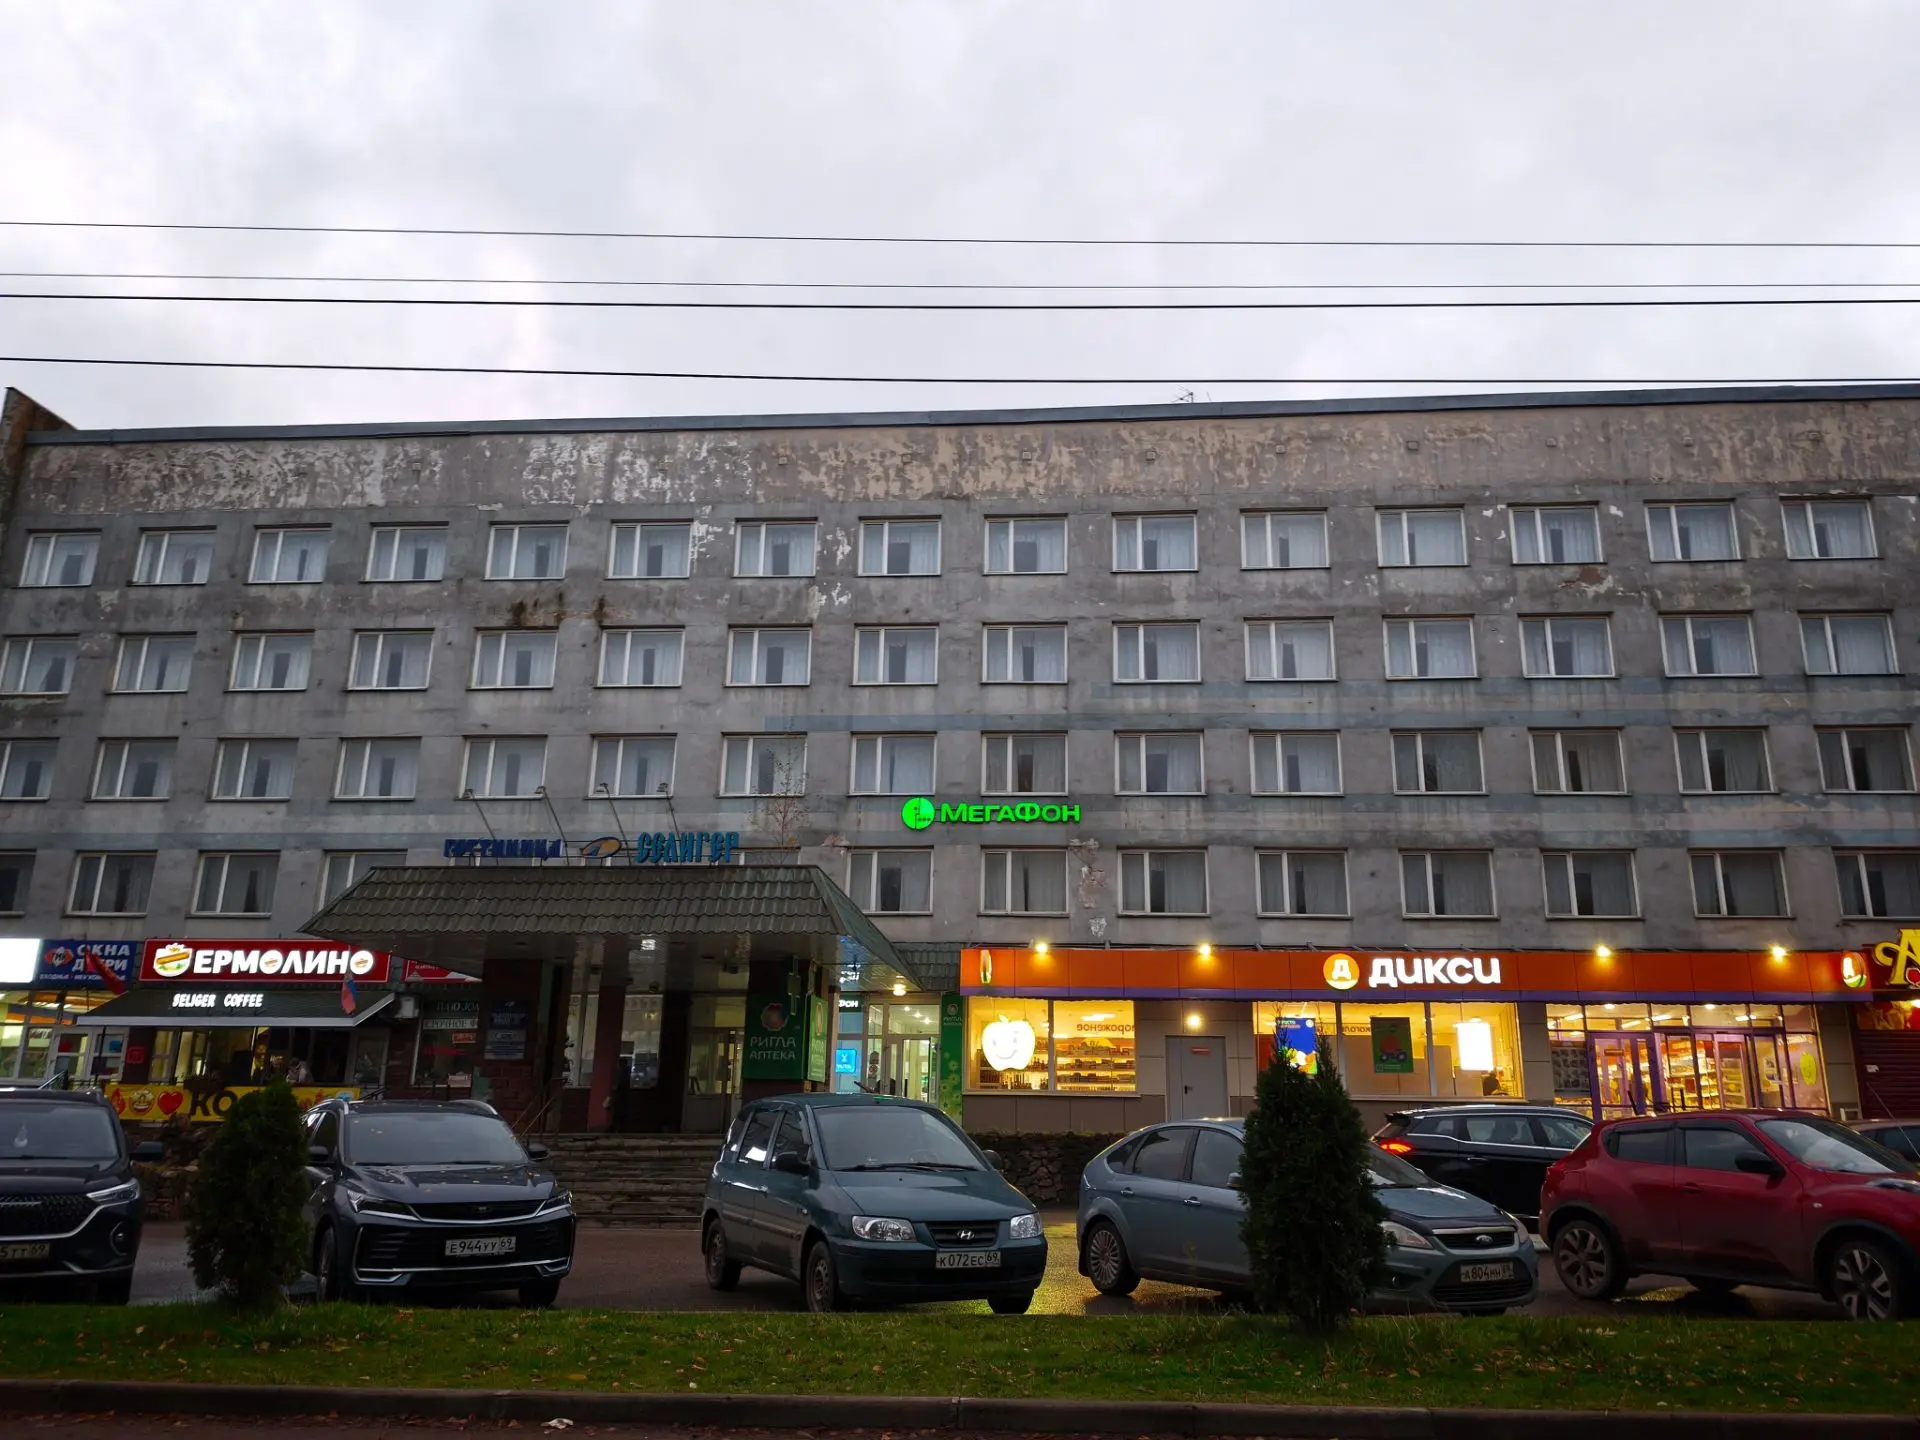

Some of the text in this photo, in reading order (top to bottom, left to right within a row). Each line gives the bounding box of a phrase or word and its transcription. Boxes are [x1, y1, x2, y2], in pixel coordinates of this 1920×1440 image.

[72, 958, 128, 972] ДРИ
[193, 949, 374, 975] ЕРМОЛИНО
[1368, 957, 1501, 988] ДИКСИ
[172, 993, 264, 1008] SELIGER COFFEE
[750, 1036, 796, 1048] РИГЛА
[749, 1050, 796, 1061] АПТЕКА
